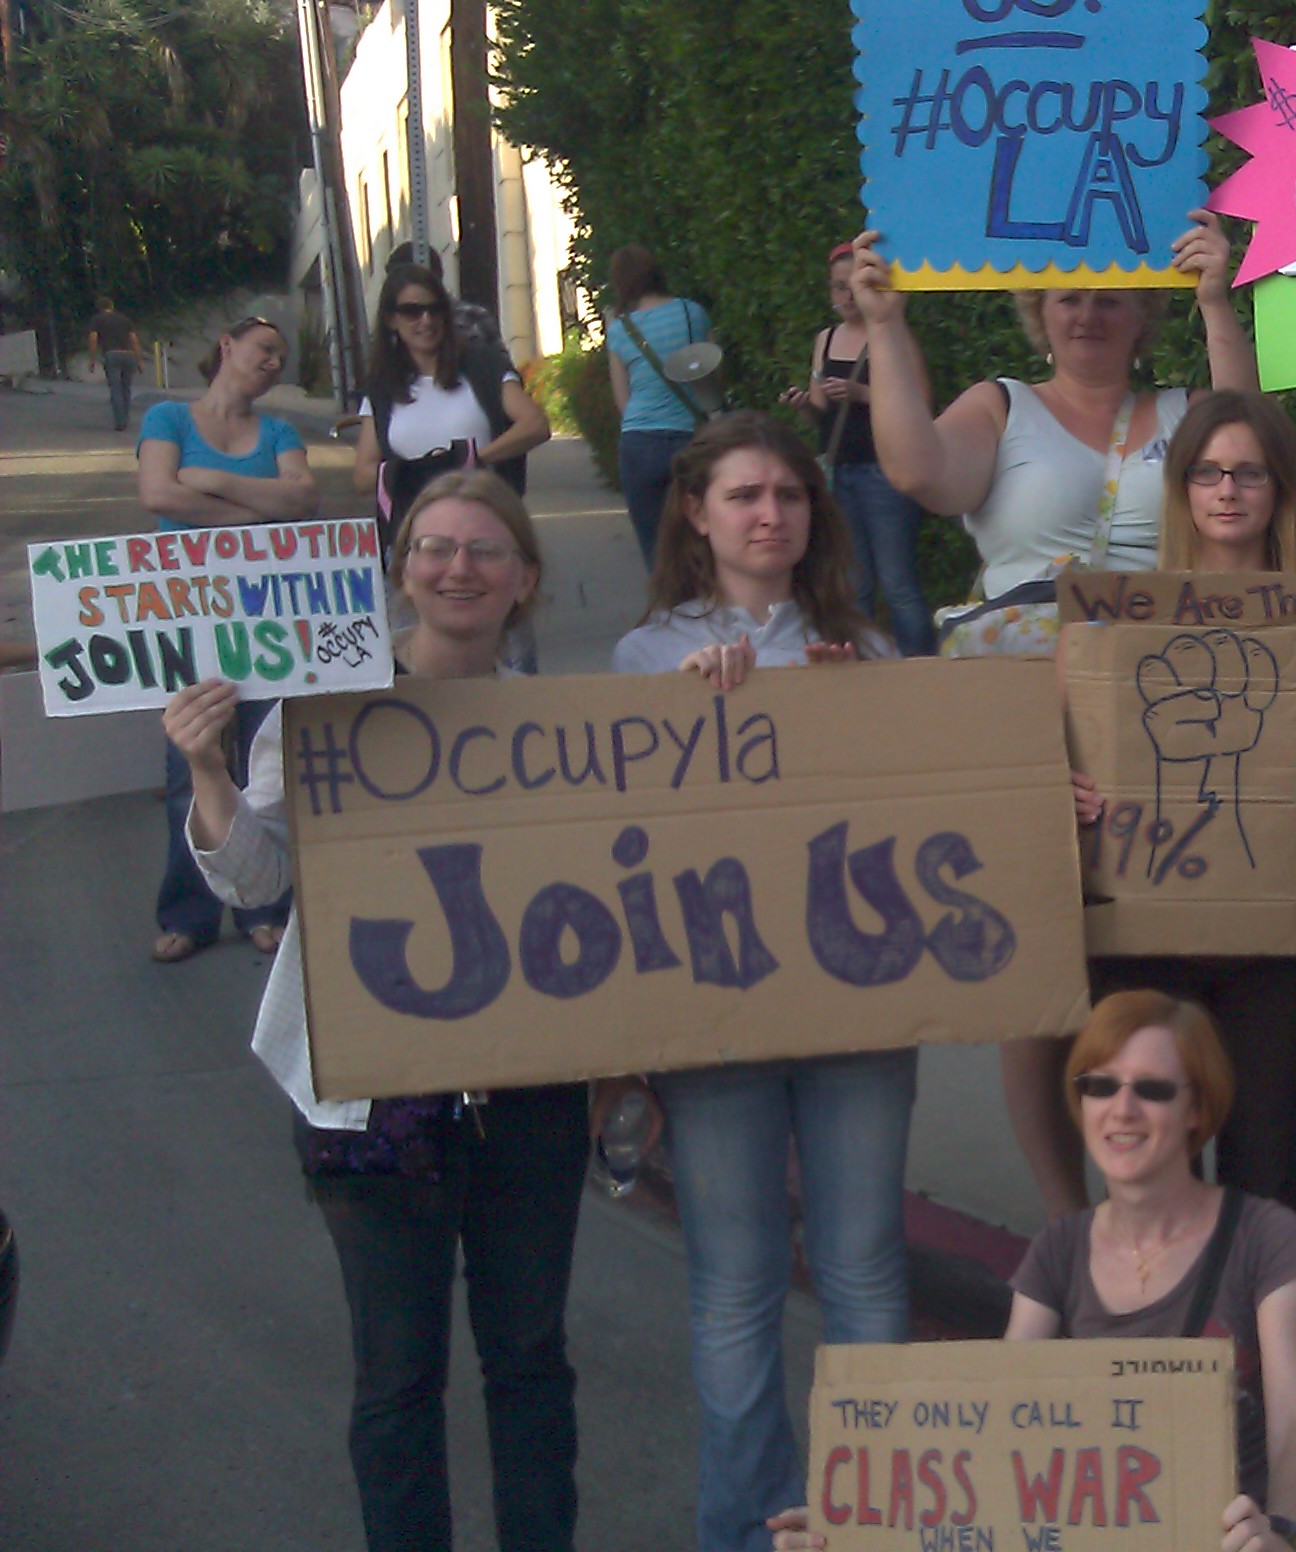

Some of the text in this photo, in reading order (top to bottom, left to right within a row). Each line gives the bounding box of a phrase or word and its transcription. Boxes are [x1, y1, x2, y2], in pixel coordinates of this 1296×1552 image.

[985, 132, 1149, 254] LA
[32, 522, 376, 583] THE REVOLUTION
[78, 568, 374, 626] STARTS WITHIN
[1071, 576, 1155, 621] We
[1174, 580, 1245, 625] Are
[45, 619, 318, 701] JOIN US!
[349, 825, 781, 1021] Join
[832, 1399, 1144, 1434] THEY ONLY CALL IT
[822, 1444, 1162, 1530] CLASS WAR
[920, 1526, 1062, 1552] WHEN WE
